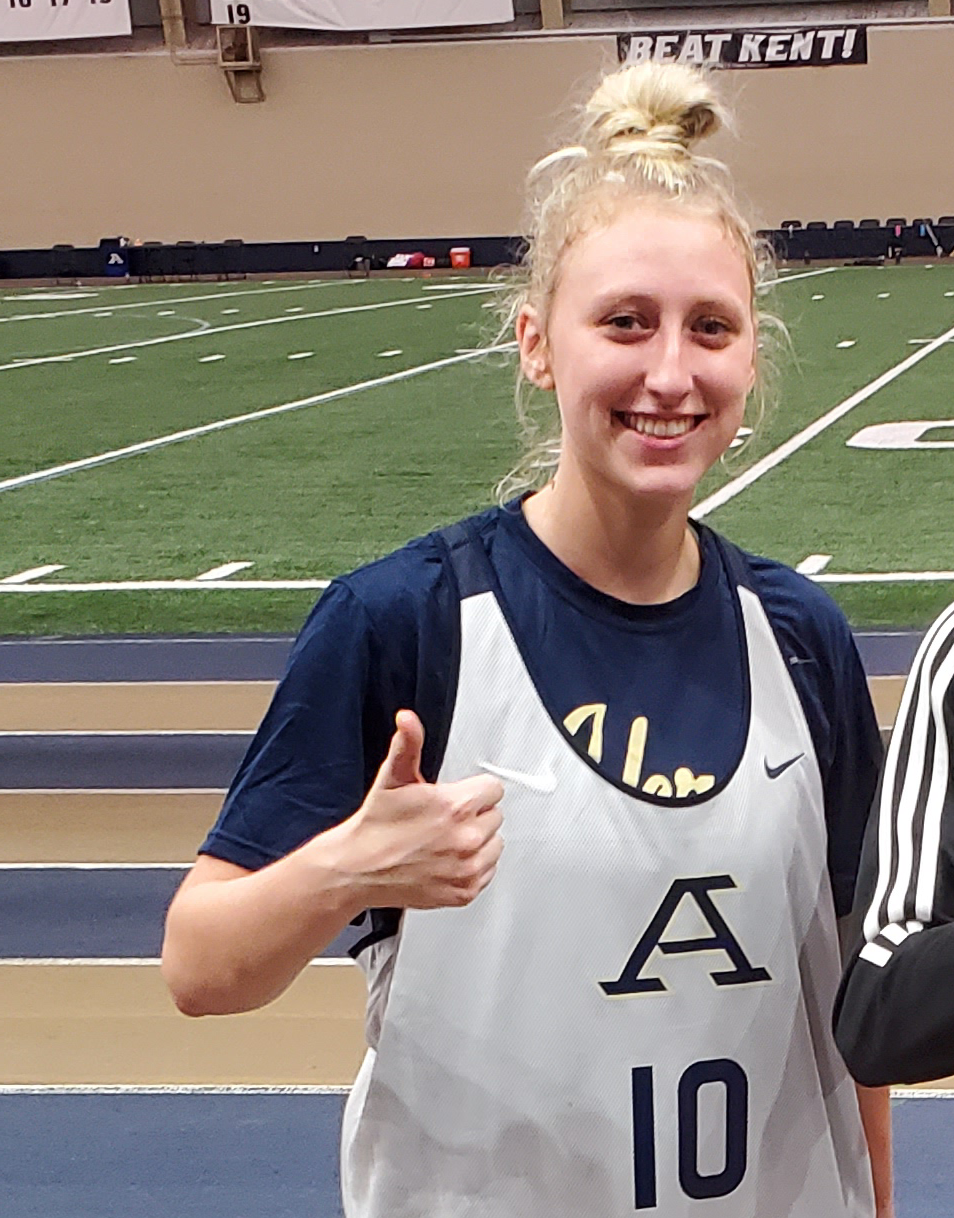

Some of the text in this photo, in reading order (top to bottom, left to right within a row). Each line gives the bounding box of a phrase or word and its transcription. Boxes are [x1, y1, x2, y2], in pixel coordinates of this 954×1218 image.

[227, 3, 251, 25] 19
[624, 28, 857, 65] BEAT KENT!
[597, 873, 775, 997] A
[631, 1057, 749, 1211] 10
